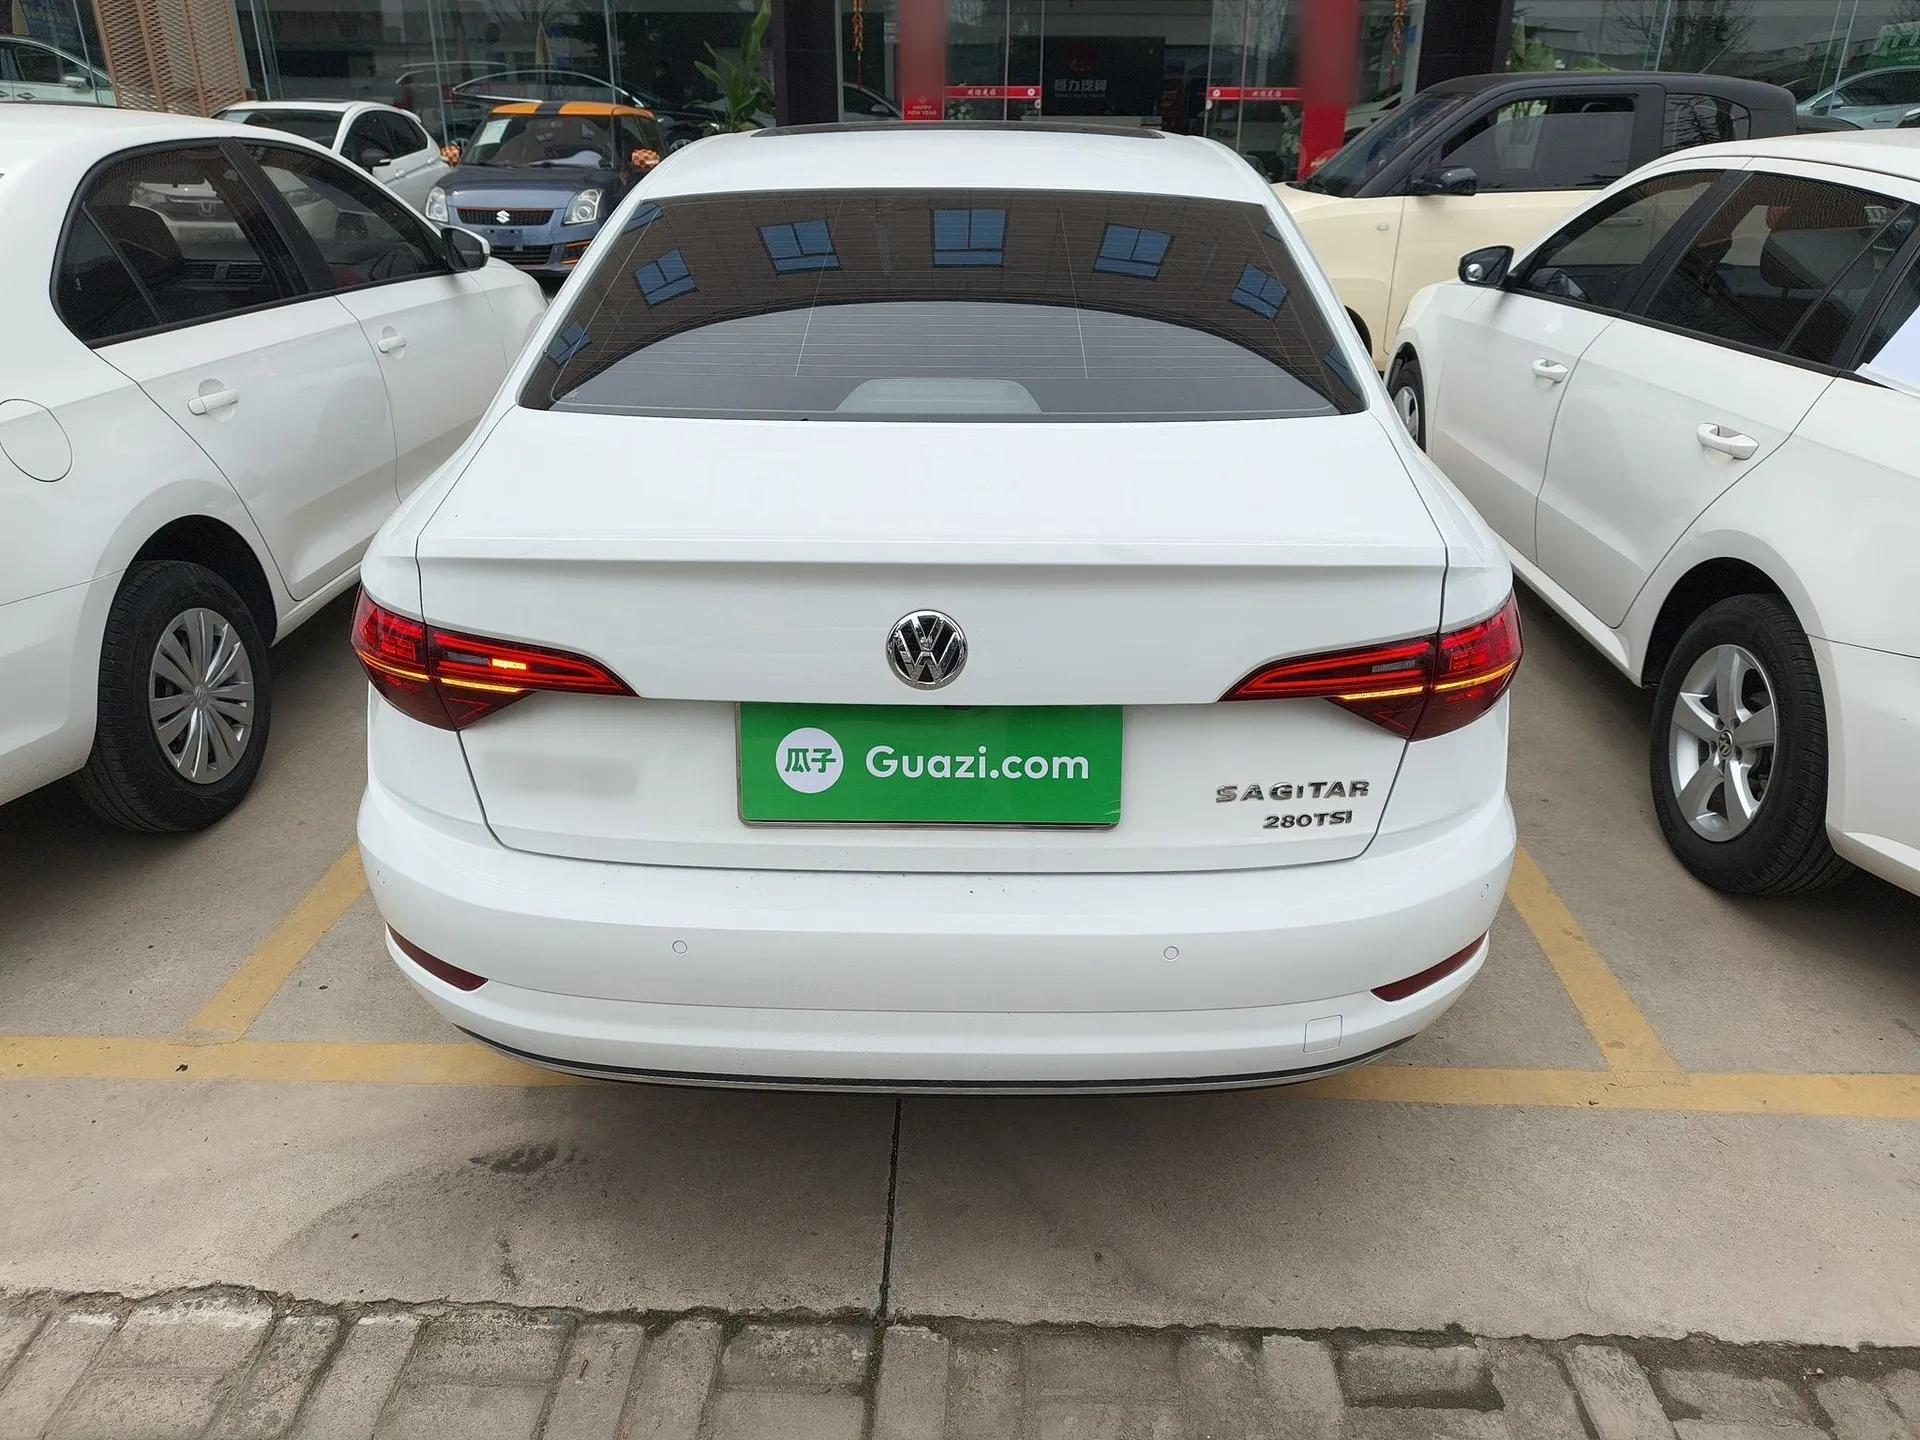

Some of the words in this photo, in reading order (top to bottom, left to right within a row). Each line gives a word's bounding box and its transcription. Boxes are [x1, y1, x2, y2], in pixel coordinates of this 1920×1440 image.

[784, 748, 837, 773] 瓜子
[865, 745, 1089, 780] Guazi.com
[1216, 781, 1370, 803] SAGITAR
[1263, 810, 1353, 829] 280TSI
